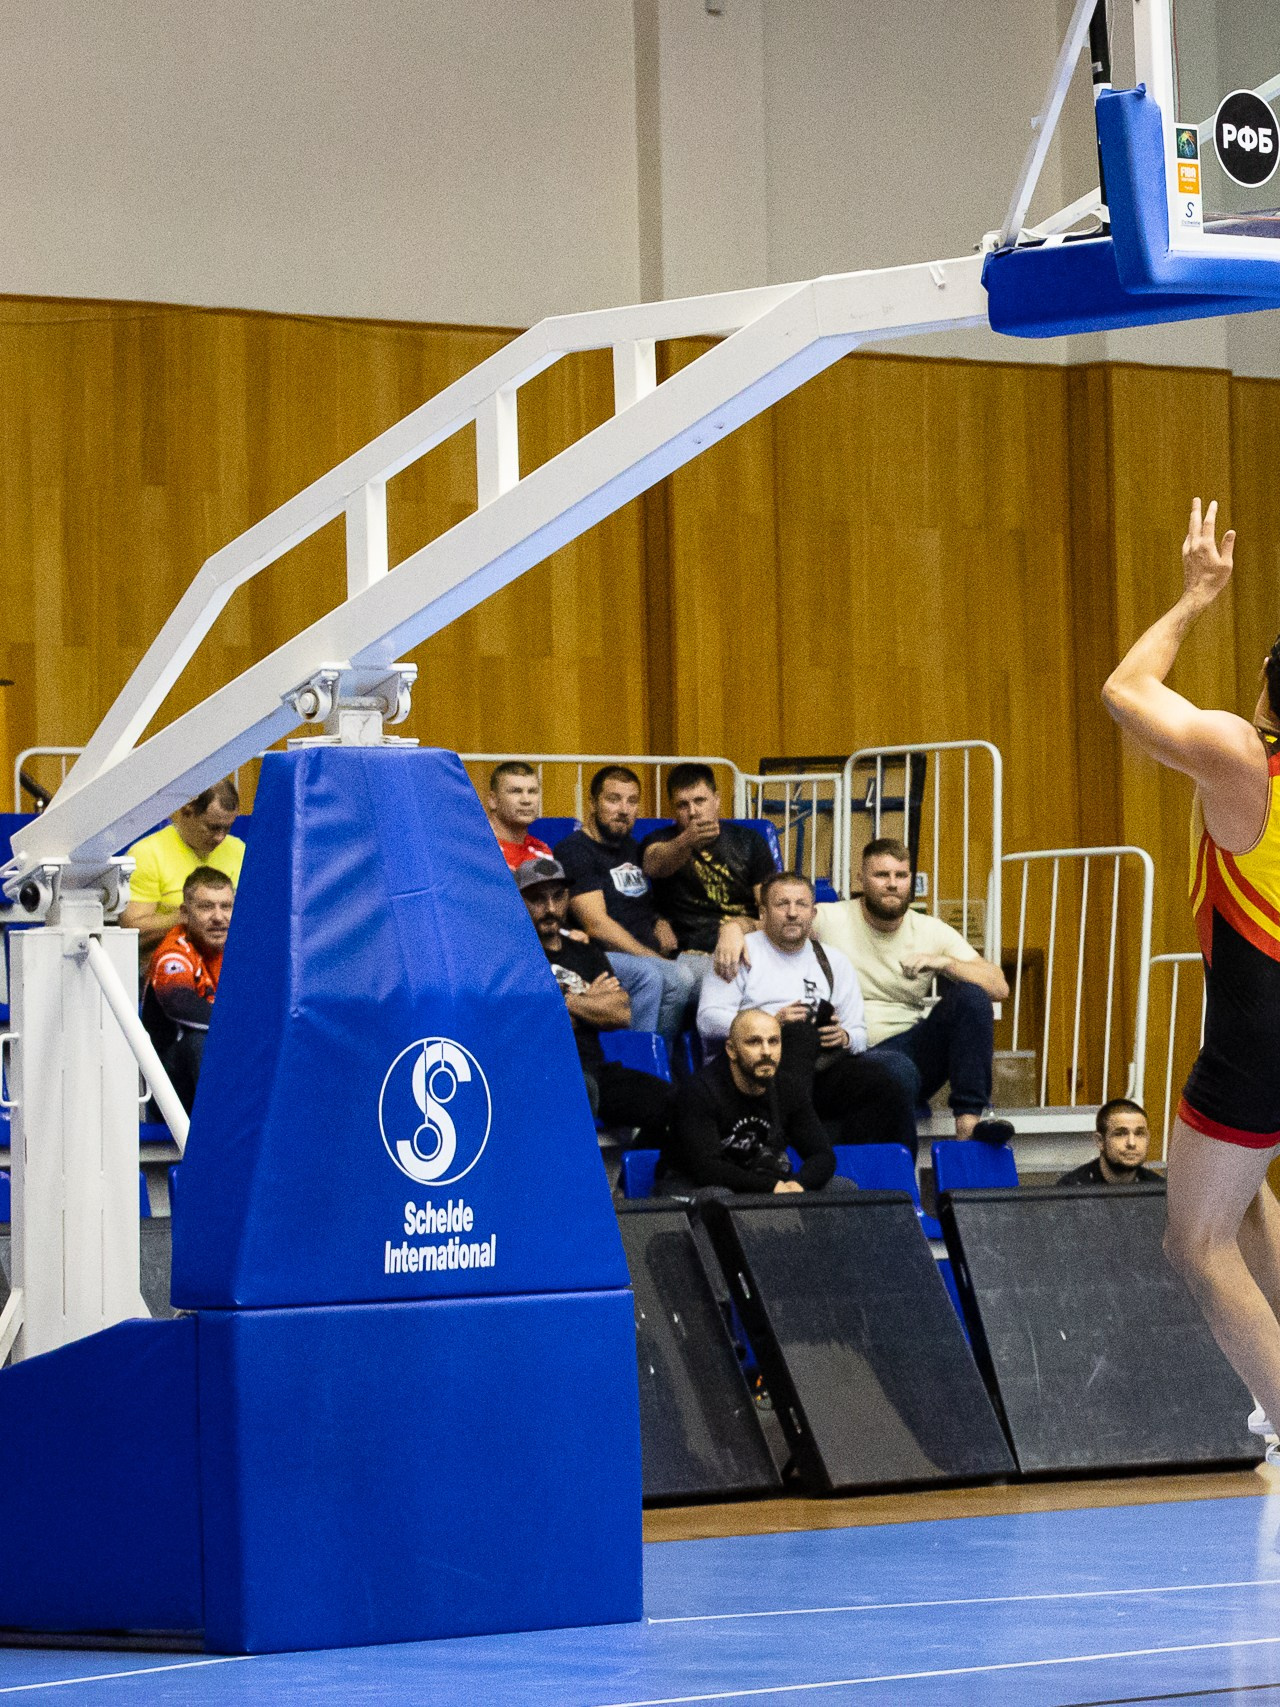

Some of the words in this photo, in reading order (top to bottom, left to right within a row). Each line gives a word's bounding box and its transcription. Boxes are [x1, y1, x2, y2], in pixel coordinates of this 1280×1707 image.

[1222, 123, 1273, 154] РФБ
[404, 1199, 474, 1236] Schelde
[384, 1233, 497, 1275] International
